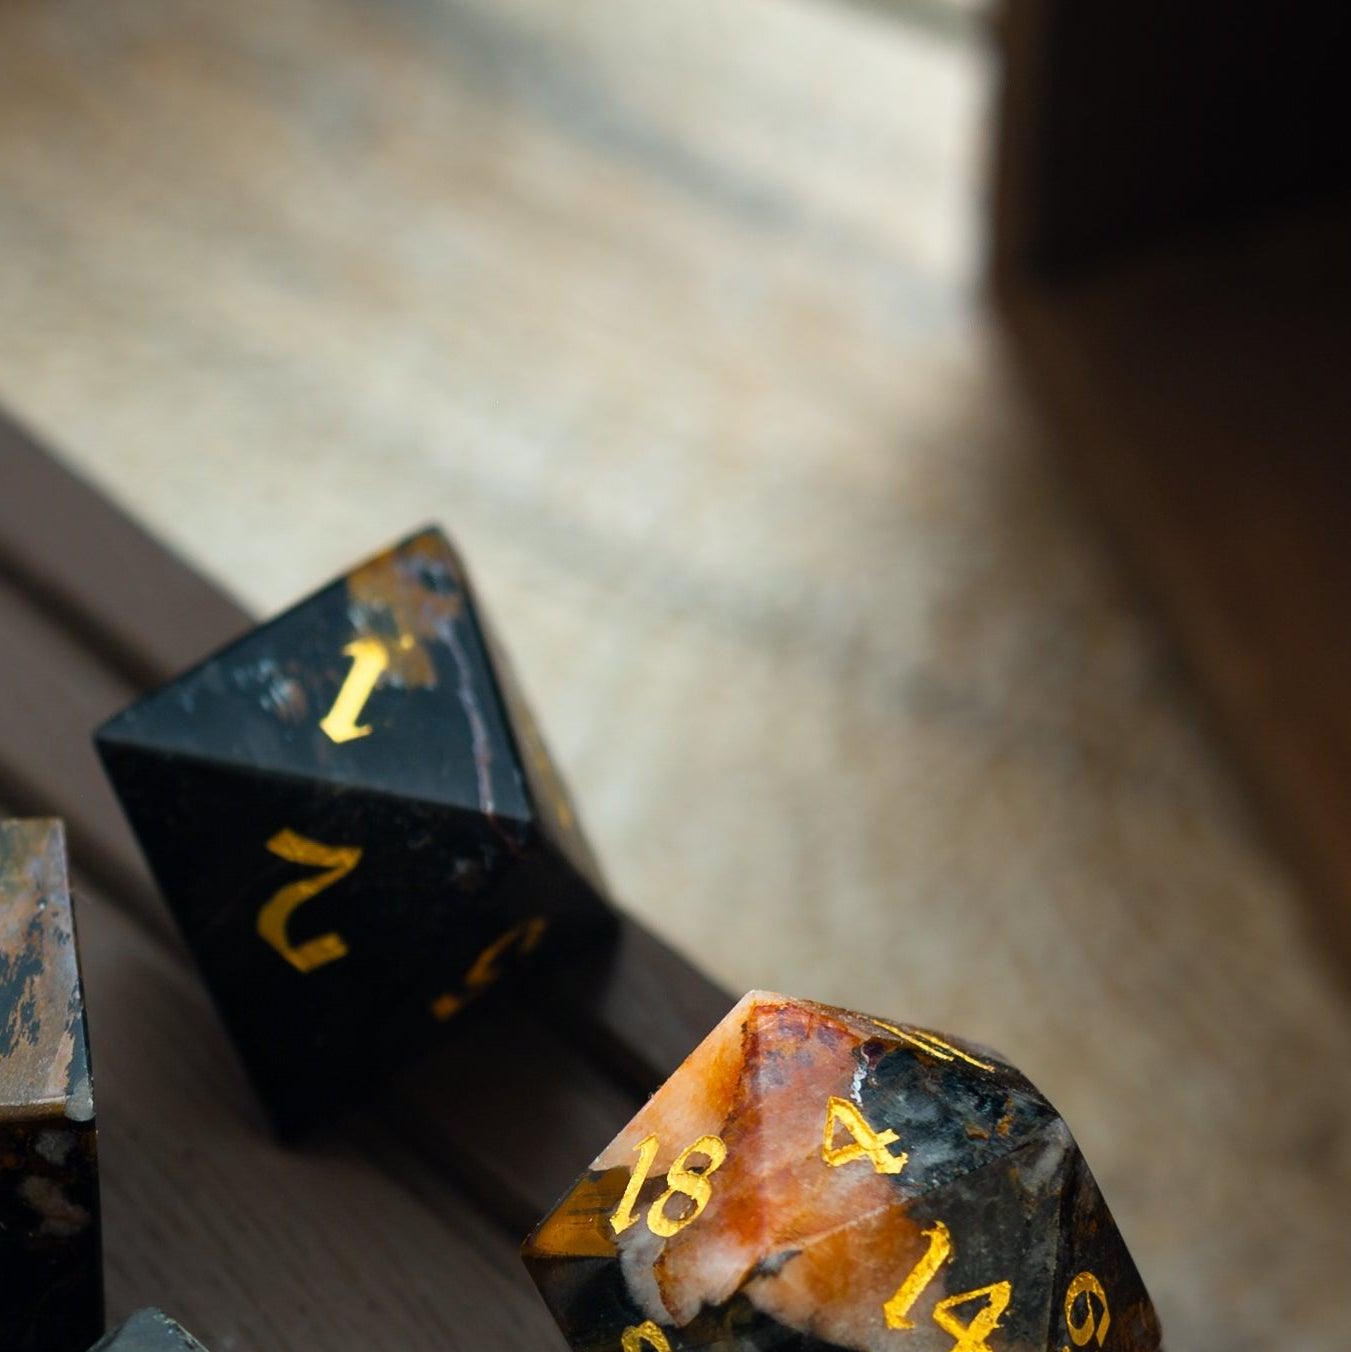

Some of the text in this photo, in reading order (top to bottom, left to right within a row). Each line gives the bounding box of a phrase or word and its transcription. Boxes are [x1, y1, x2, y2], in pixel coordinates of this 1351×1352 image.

[319, 634, 389, 744] 1
[257, 829, 363, 973] 2
[609, 1134, 727, 1238] 18
[822, 1096, 908, 1174] 4
